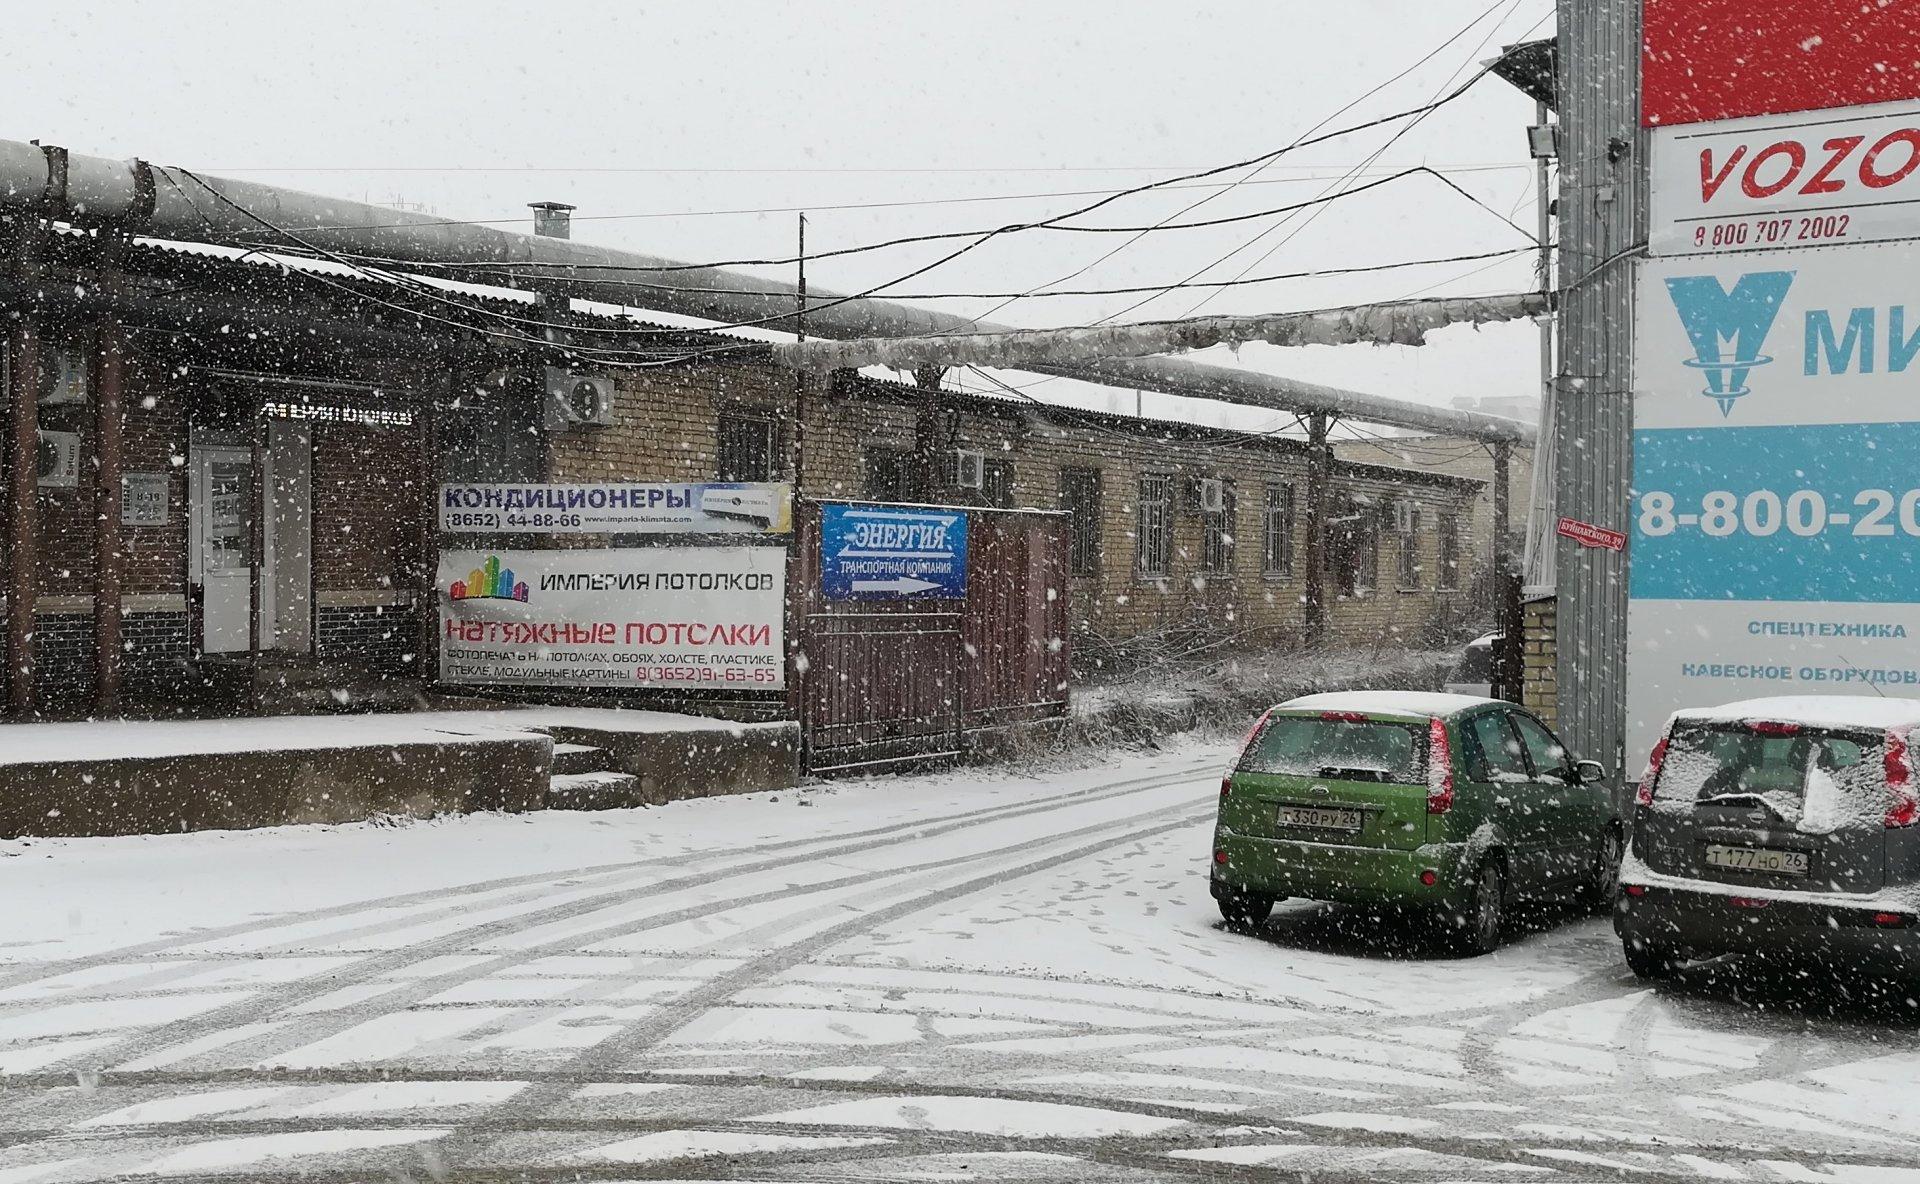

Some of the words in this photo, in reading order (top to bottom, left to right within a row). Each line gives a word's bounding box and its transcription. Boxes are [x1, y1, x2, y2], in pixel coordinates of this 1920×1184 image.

[1699, 128, 1920, 203] VOZO
[1712, 223, 1748, 246] 800
[1755, 219, 1792, 243] 707
[1797, 214, 1850, 241] 2002
[445, 488, 692, 512] КОНДИЦИОНЕРЫ
[445, 513, 500, 530] (8652)
[506, 513, 581, 528] 44-88-66
[855, 523, 946, 549] ЭНЕРГИЯ
[840, 561, 905, 573] ТРАНСПОРТНАЯ
[906, 562, 952, 574] КОМПАНИЯ
[540, 573, 650, 591] ИМПЕРИЯ
[655, 573, 773, 591] ПОТОЛКОВ
[625, 622, 770, 646] ПОТОЛКИ
[1748, 621, 1907, 638] СПЕЦТЕХНИКА
[547, 652, 609, 663] ПОТОЛКАХ,
[612, 653, 656, 664] ОБОЯХ,
[659, 654, 708, 664] ХОЛСТЕ,
[711, 654, 777, 665] ПЛАСТИКЕ,
[494, 666, 569, 678] МОДУЛЬНЫЕ
[572, 669, 630, 679] КАРТИНЫ
[1682, 663, 1792, 680] НАВЕСНОЕ
[1800, 666, 1920, 685] ОБОРУДОВ
